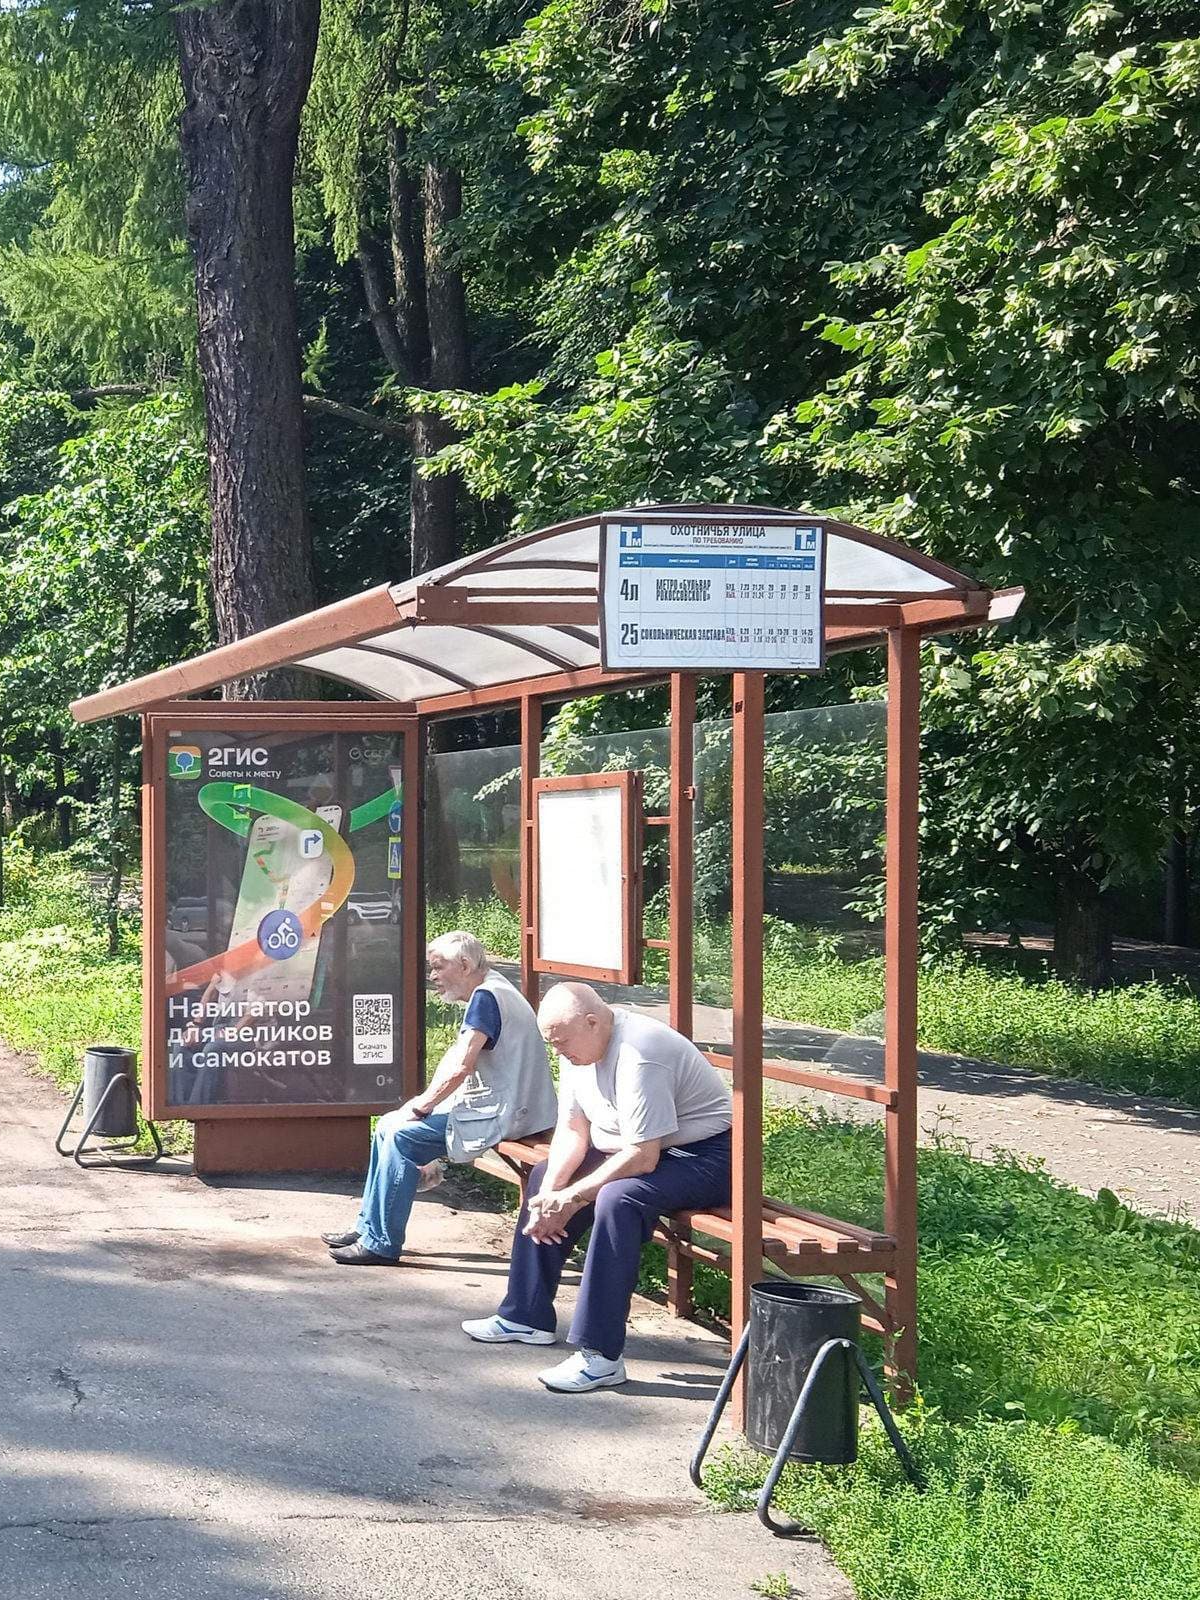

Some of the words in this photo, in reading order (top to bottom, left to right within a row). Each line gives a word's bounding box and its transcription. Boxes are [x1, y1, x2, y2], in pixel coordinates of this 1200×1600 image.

[670, 525, 730, 537] ОХОТНИЧЬЯ
[732, 526, 766, 538] УЛИЦА
[703, 537, 744, 545] ТРЕБОВАНИЮ
[656, 579, 678, 591] МЕТРО
[621, 623, 639, 645] 25
[641, 628, 697, 640] СОКОЛЬНИЧЕСКАЯ
[698, 629, 726, 641] ЗАСТАВА
[208, 747, 269, 766] 2ГИС
[208, 769, 244, 778] Советы
[253, 770, 282, 780] месту
[168, 996, 311, 1022] Навигатор
[167, 1026, 215, 1047] для
[224, 1024, 333, 1042] великов
[168, 1052, 184, 1069] и
[192, 1049, 332, 1067] самокатов
[362, 1051, 384, 1059] 2ГИС
[376, 1074, 394, 1087] 0+
